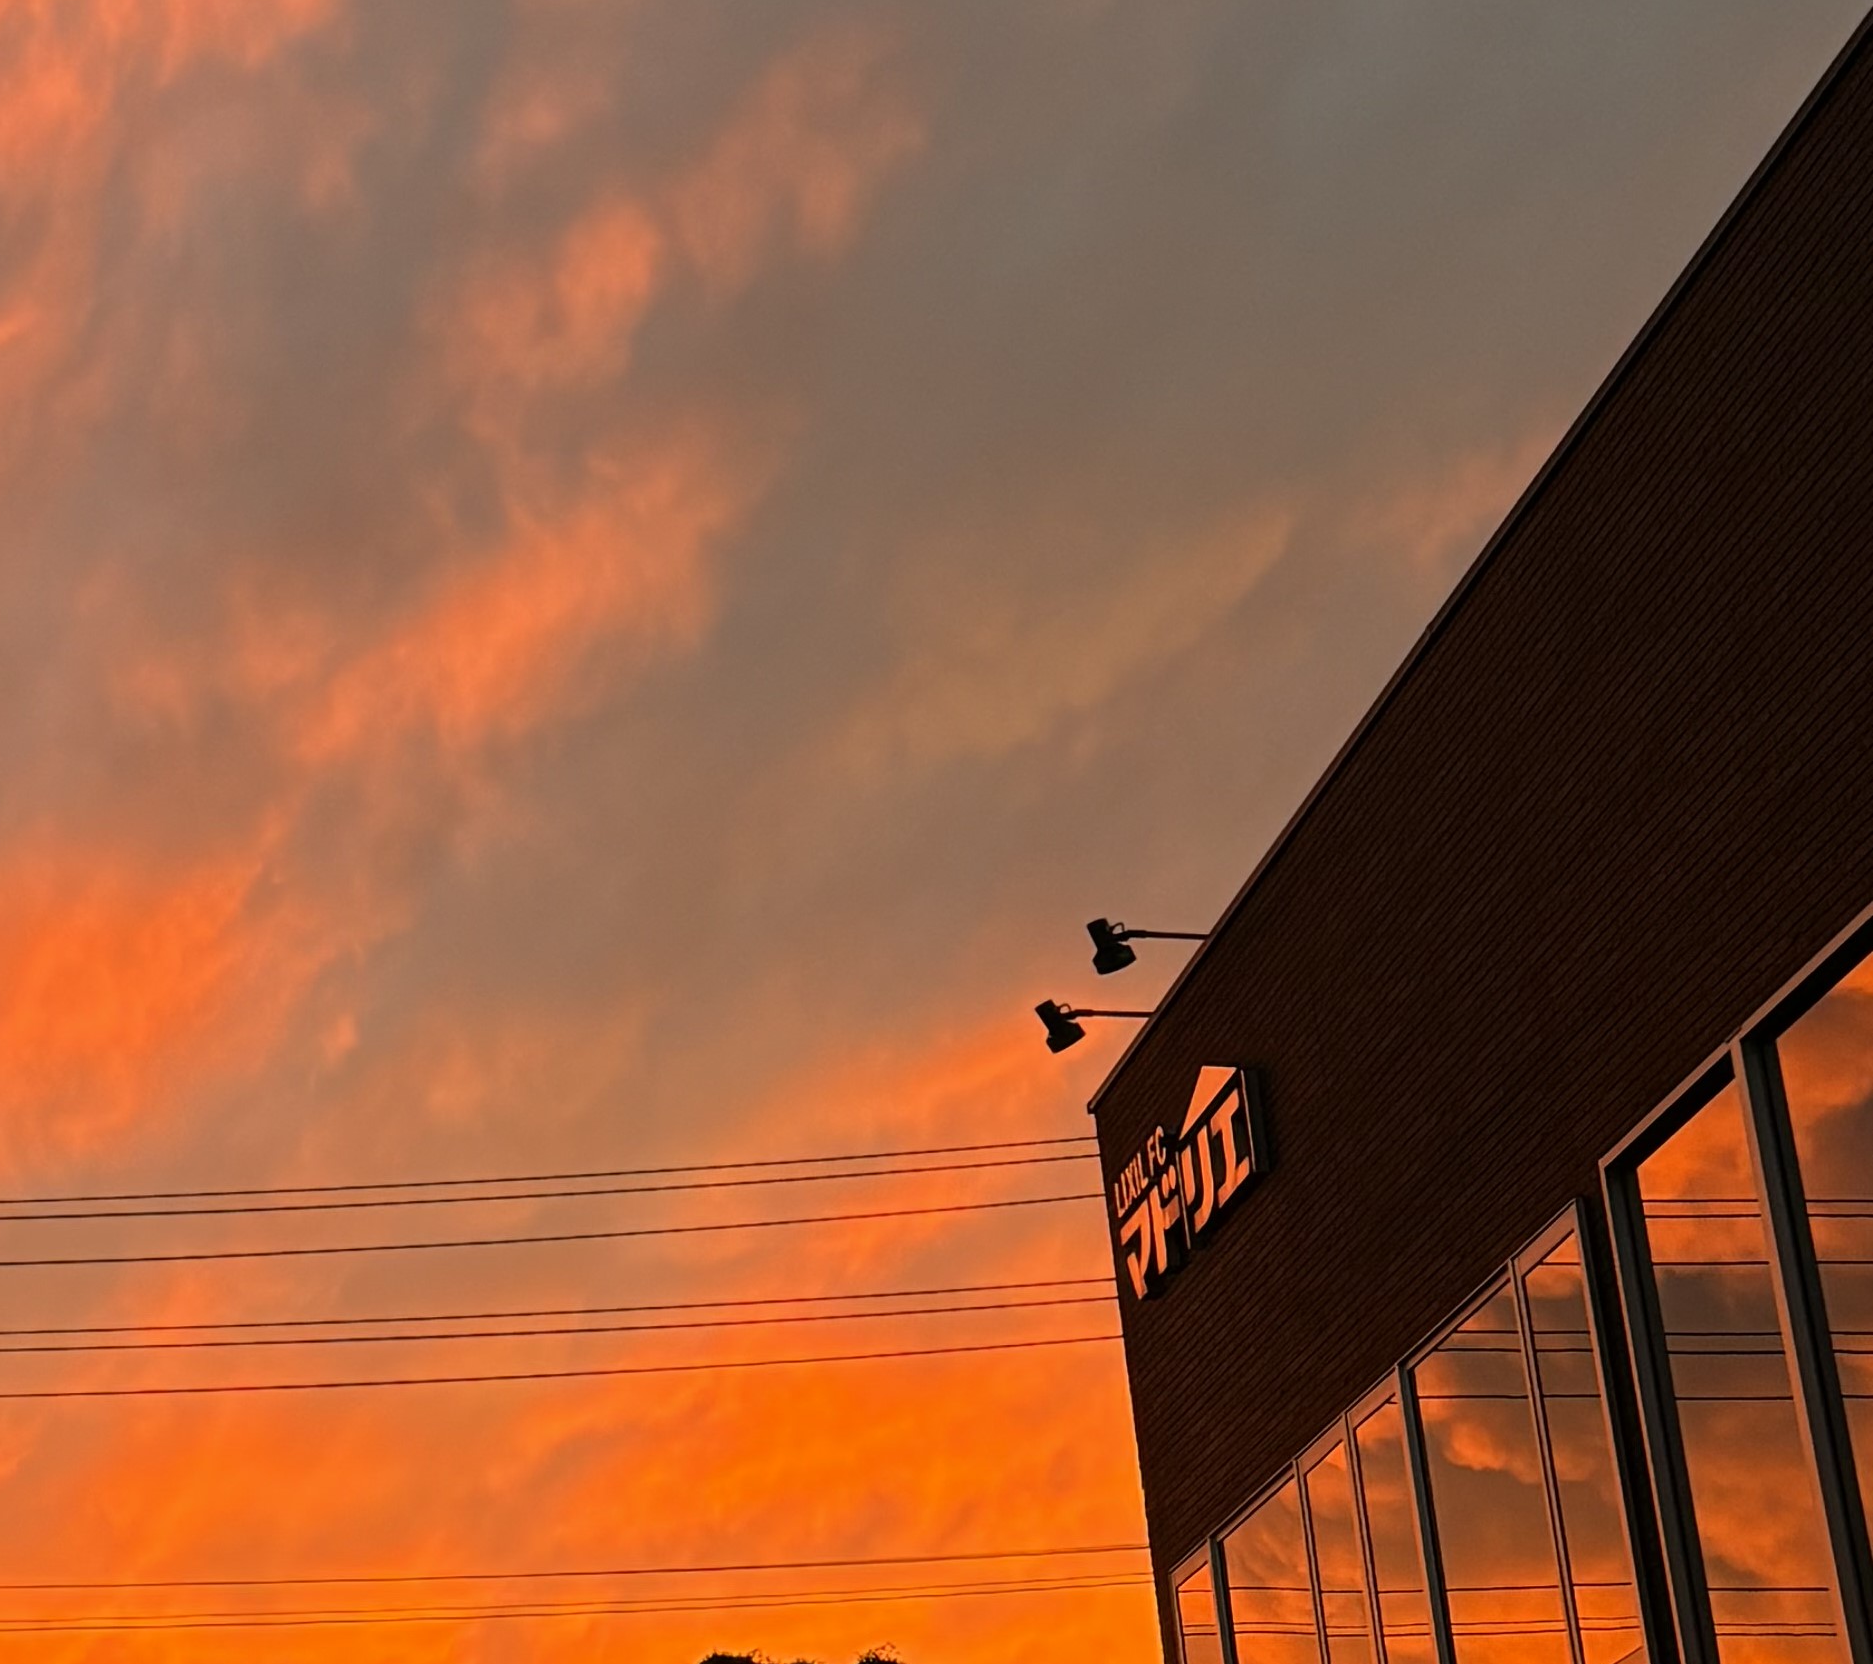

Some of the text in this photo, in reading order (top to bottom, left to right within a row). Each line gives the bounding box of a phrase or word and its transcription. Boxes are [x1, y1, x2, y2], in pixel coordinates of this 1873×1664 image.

[1114, 1125, 1167, 1218] LIXIL FC
[1120, 1088, 1250, 1300] マドリエ
